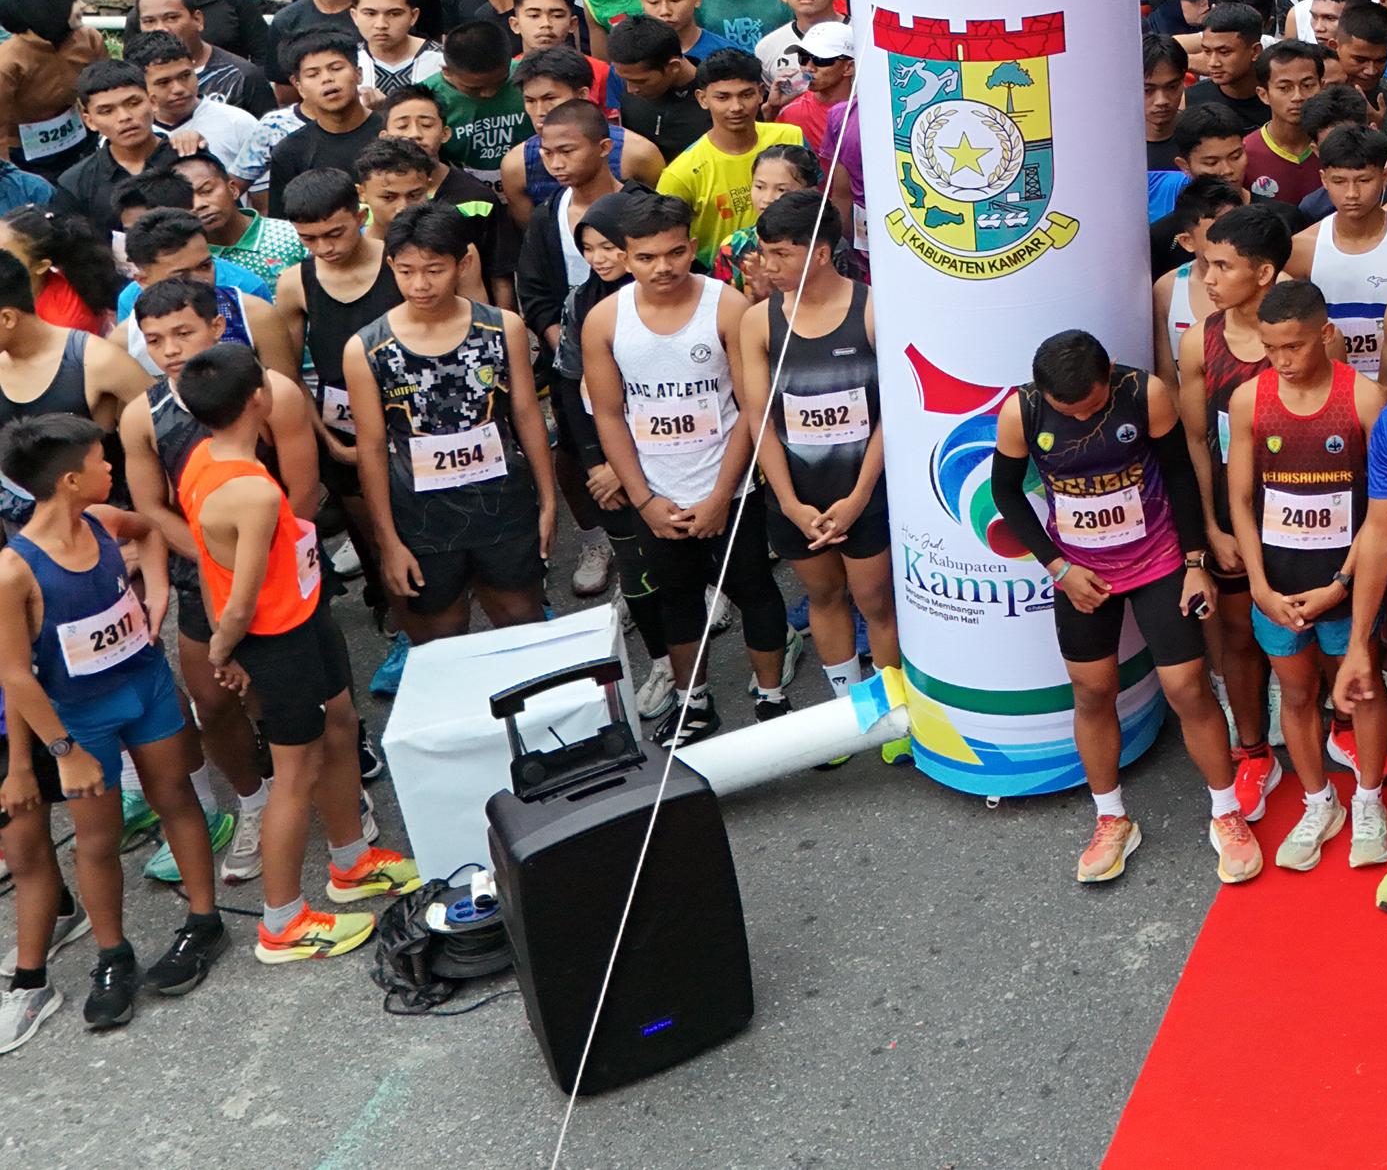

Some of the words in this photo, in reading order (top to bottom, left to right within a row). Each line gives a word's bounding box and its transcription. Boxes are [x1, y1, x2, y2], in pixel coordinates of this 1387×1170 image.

[456, 112, 525, 140] PRESUNIV
[473, 126, 514, 151] RUN
[480, 143, 511, 161] 2025
[910, 233, 985, 275] KABUPATEN
[984, 238, 1046, 271] KAMPAR
[649, 414, 695, 436] 2518
[800, 406, 851, 429] 2582
[432, 444, 484, 471] 2154
[1072, 505, 1126, 530] 2300
[1281, 507, 1332, 530] 2408
[929, 551, 1008, 576] Kabupaten
[929, 607, 960, 622] Dengan
[961, 615, 980, 625] Hati
[931, 598, 985, 616] Membangun
[89, 611, 136, 653] 2317
